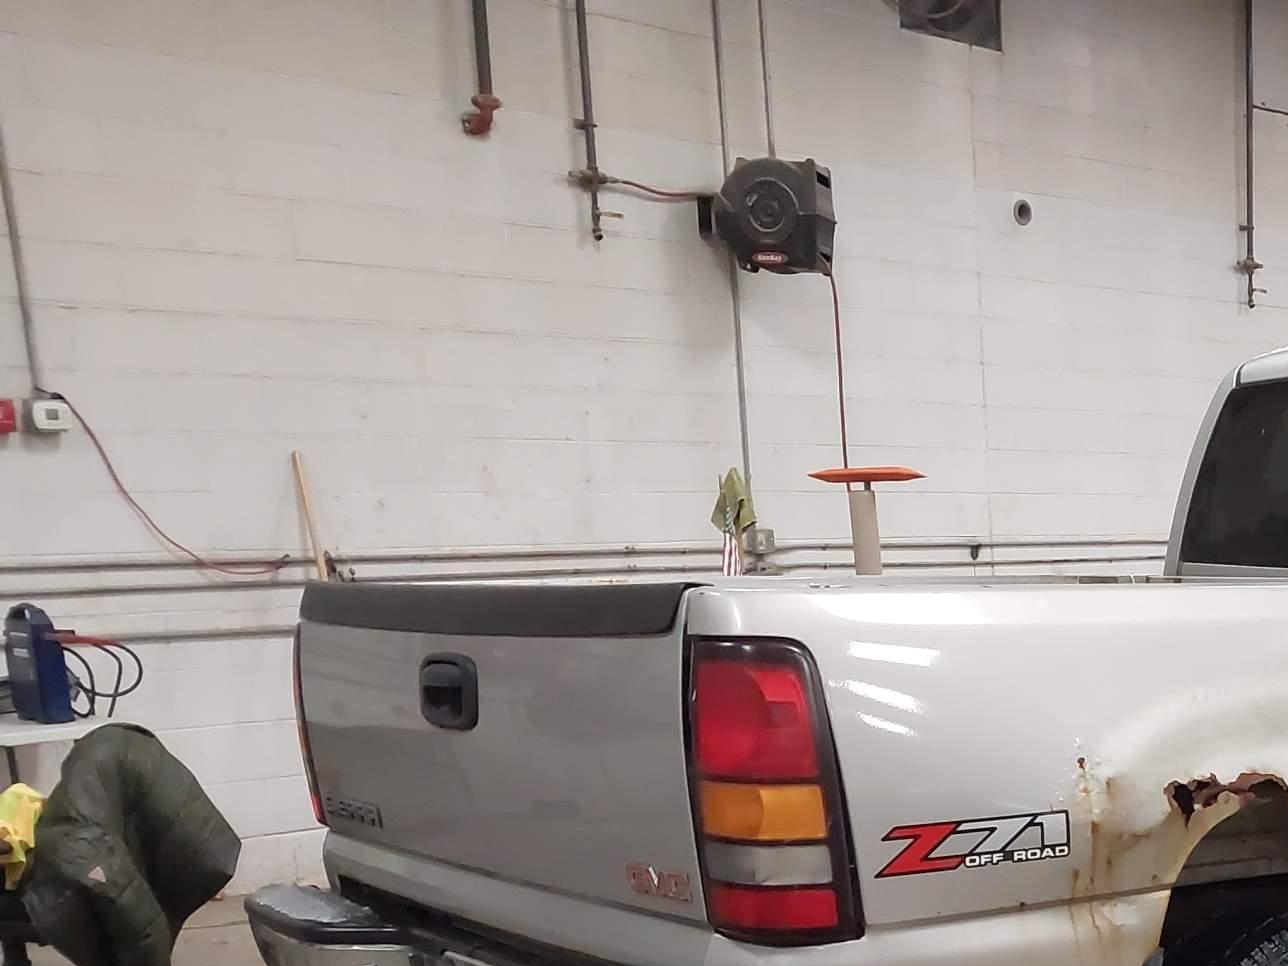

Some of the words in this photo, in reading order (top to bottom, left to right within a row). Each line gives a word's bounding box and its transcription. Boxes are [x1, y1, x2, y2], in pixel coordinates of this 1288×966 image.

[874, 810, 1070, 879] Z71
[964, 853, 1004, 868] OFF
[1013, 846, 1069, 862] ROAD
[625, 864, 693, 903] GMC
